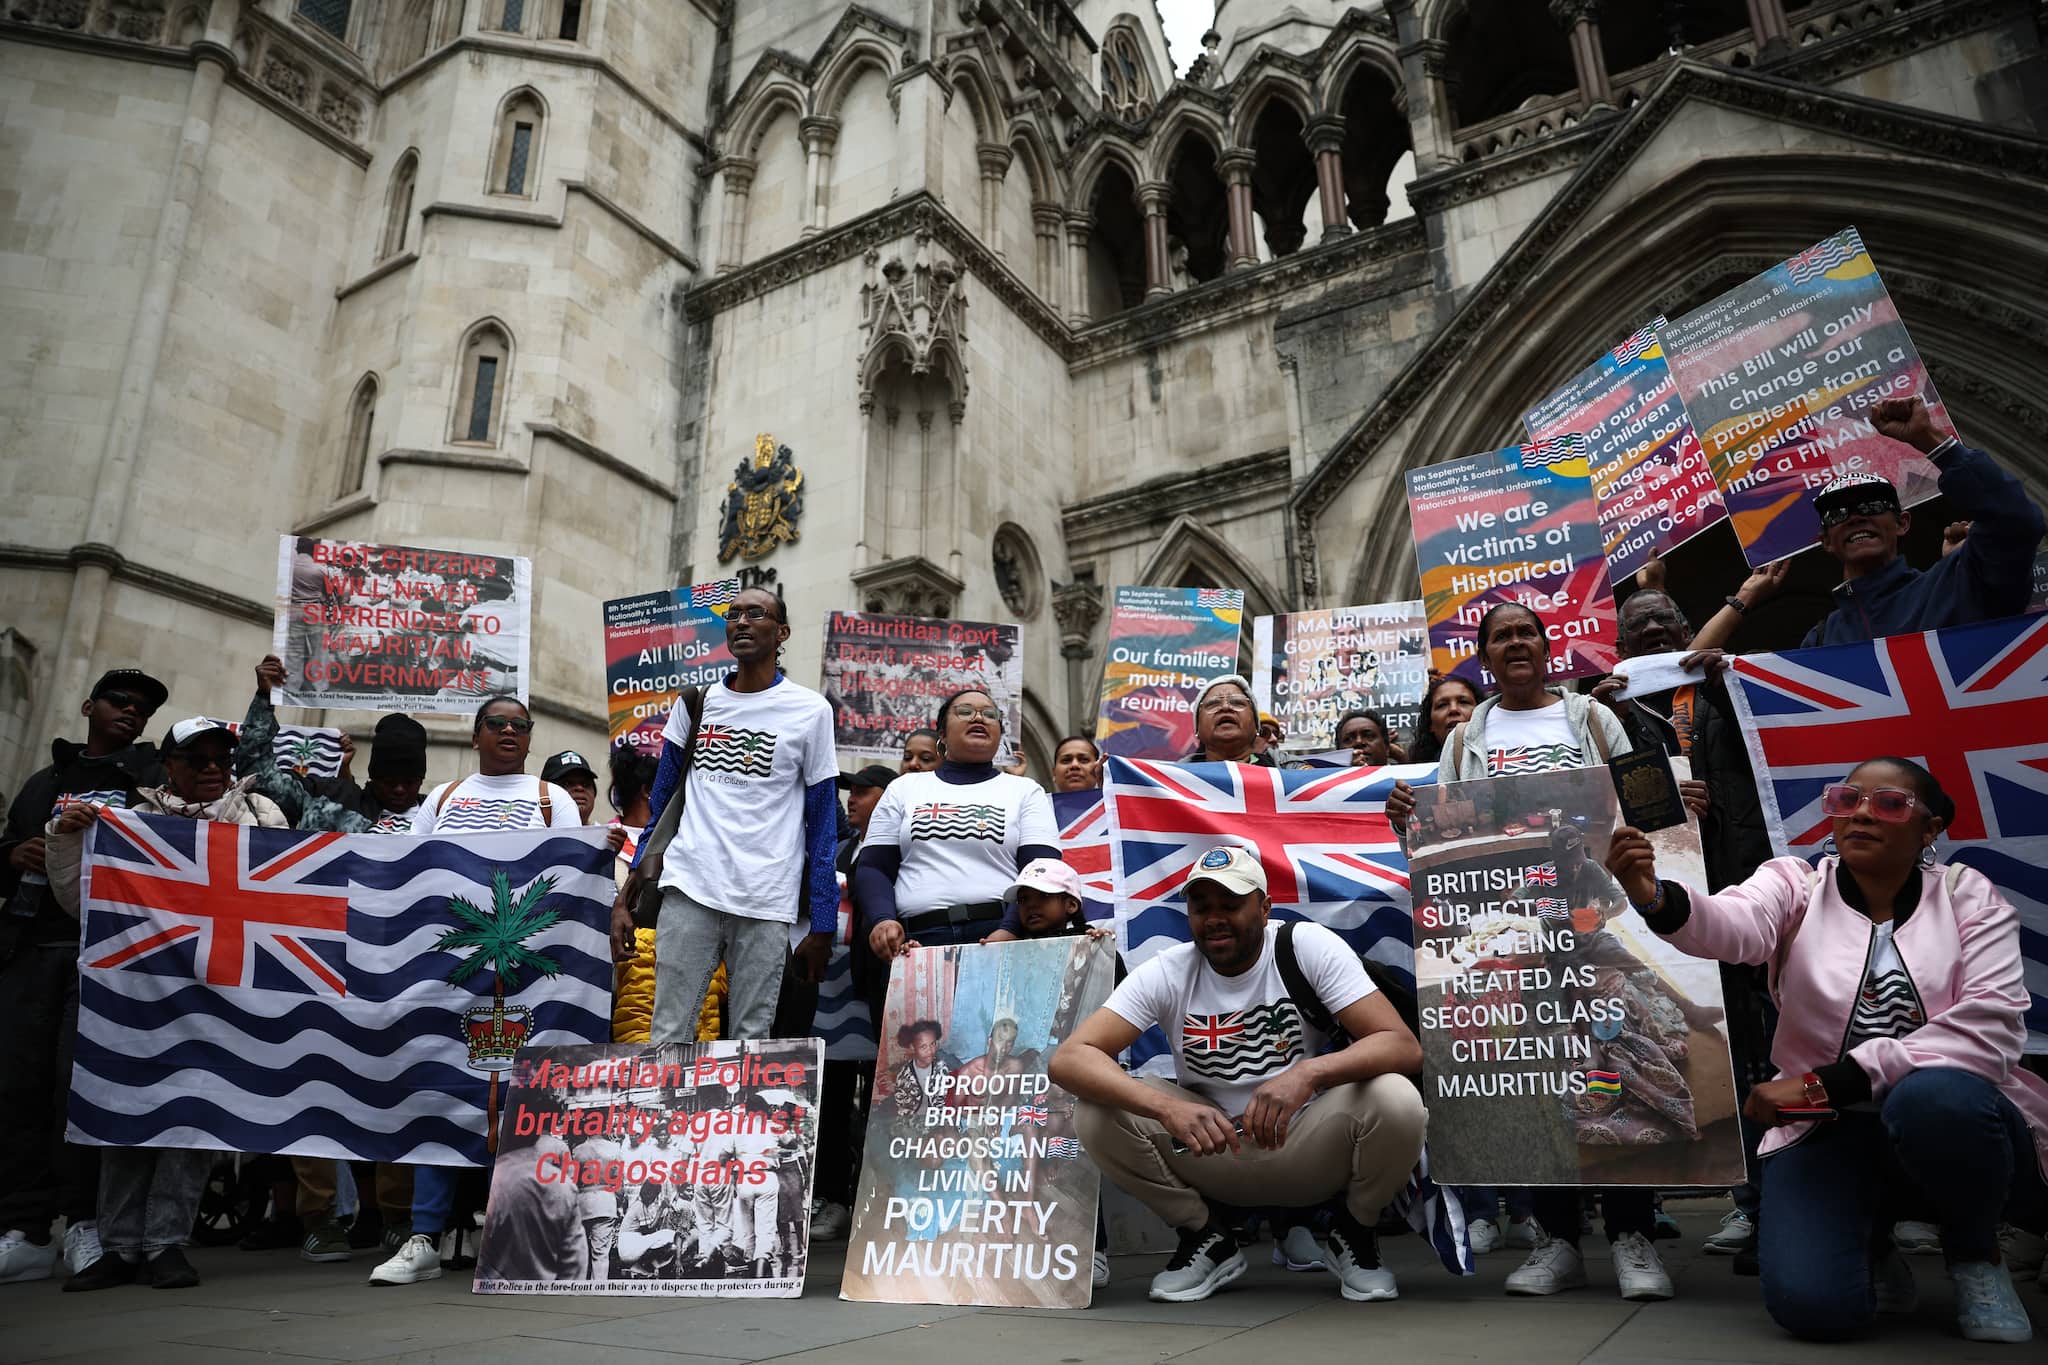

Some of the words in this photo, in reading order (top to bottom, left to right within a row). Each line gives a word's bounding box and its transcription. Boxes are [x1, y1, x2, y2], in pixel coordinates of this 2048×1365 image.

[1670, 319, 1721, 349] Nationality
[1734, 294, 1771, 316] Borders
[1773, 284, 1788, 295] Bill
[1679, 343, 1723, 369] Historical
[1725, 315, 1776, 345] Legislative
[1779, 286, 1832, 317] Unfairness
[1666, 328, 1681, 340] 8th
[1681, 326, 1734, 356] Citizenship
[1697, 372, 1739, 399] This
[1742, 350, 1776, 376] Bill
[1779, 328, 1818, 358] will
[1824, 302, 1873, 337] only
[1729, 360, 1818, 410] change
[1825, 336, 1863, 364] our
[1610, 402, 1635, 425] our
[1713, 387, 1820, 449] problems
[1823, 358, 1880, 393] from
[1888, 347, 1905, 363] a
[1603, 403, 1670, 453] children
[1725, 406, 1842, 467] legislative
[1847, 374, 1911, 411] issue
[1726, 468, 1770, 494] into
[1777, 457, 1793, 472] a
[1798, 392, 1934, 463] FINANL
[1591, 454, 1623, 483] nnot
[1626, 440, 1650, 459] be
[1802, 454, 1871, 489] issue.
[1414, 476, 1460, 492] Nationality
[1471, 468, 1503, 480] Borders
[1506, 463, 1518, 472] Bill
[1423, 484, 1469, 500] Citizenship
[1597, 455, 1667, 500] Chagos,
[1417, 496, 1456, 511] Historical
[1458, 488, 1504, 503] Legislative
[1506, 477, 1552, 492] Unfairness
[1598, 485, 1646, 526] nned
[1649, 474, 1669, 490] us
[1618, 498, 1668, 533] home
[1670, 485, 1689, 500] in
[1691, 470, 1711, 488] th
[1455, 511, 1496, 533] We
[1505, 500, 1549, 523] are
[1444, 533, 1537, 566] victims
[1546, 521, 1571, 545] of
[1606, 530, 1655, 566] ndian
[313, 543, 374, 567] BIOT
[382, 550, 497, 577] CITIZENS
[1452, 553, 1575, 595] Historical
[324, 576, 385, 599] WILL
[395, 579, 478, 604] NEVER
[303, 604, 460, 632] SURRENDER
[467, 614, 501, 635] TO
[1298, 611, 1409, 633] MAURITIAN
[1458, 590, 1578, 626] Injtice.
[834, 614, 941, 640] Mauritian
[950, 624, 999, 645] Govt
[1284, 628, 1424, 654] GOVERNMENT
[1446, 636, 1478, 658] Th
[1546, 616, 1599, 640] can
[321, 632, 472, 660] MAURITIAN
[638, 647, 661, 667] All
[668, 640, 710, 661] Illois
[839, 643, 895, 665] Don't
[903, 651, 985, 672] respect
[1113, 648, 1149, 663] Our
[1153, 649, 1230, 668] families
[1367, 651, 1409, 667] OUR
[305, 661, 492, 691] GOVERNMENT
[1129, 673, 1176, 688] must
[1181, 673, 1207, 689] be
[1276, 670, 1428, 696] COMPENSATIO
[633, 696, 672, 718] and
[838, 708, 924, 730] Human
[1274, 698, 1333, 715] MADE
[1337, 696, 1362, 711] US
[1368, 692, 1412, 709] LIVE
[1427, 867, 1524, 895] BRITISH
[1438, 968, 1551, 995] TREATED
[1560, 965, 1596, 988] AS
[1422, 1001, 1527, 1029] SECOND
[1536, 998, 1625, 1023] CLASS
[1452, 1036, 1554, 1062] CITIZEN
[1564, 1035, 1591, 1059] IN
[518, 1057, 681, 1089] Mauritian
[694, 1053, 806, 1087] Police
[924, 1074, 1049, 1095] UPROOTED
[1438, 1070, 1586, 1098] MAURITIUS
[515, 1104, 657, 1143] brutality
[668, 1105, 805, 1142] against
[925, 1106, 1016, 1126] BRITISH
[889, 1137, 1047, 1159] CHAGOSSIAN
[535, 1152, 767, 1192] Chagossians
[918, 1170, 997, 1192] LIVING
[1005, 1171, 1030, 1192] IN
[884, 1198, 1058, 1235] POVERTY
[862, 1242, 1078, 1280] MAURITIUS
[497, 1282, 522, 1290] Police
[525, 1281, 532, 1290] in
[536, 1282, 548, 1291] the
[551, 1282, 592, 1291] fore-front
[608, 1281, 628, 1290] their
[631, 1282, 646, 1292] way
[651, 1282, 658, 1291] to
[662, 1281, 697, 1293] disperse
[701, 1281, 714, 1291] the
[717, 1280, 761, 1292] protesters
[764, 1280, 794, 1289] during
